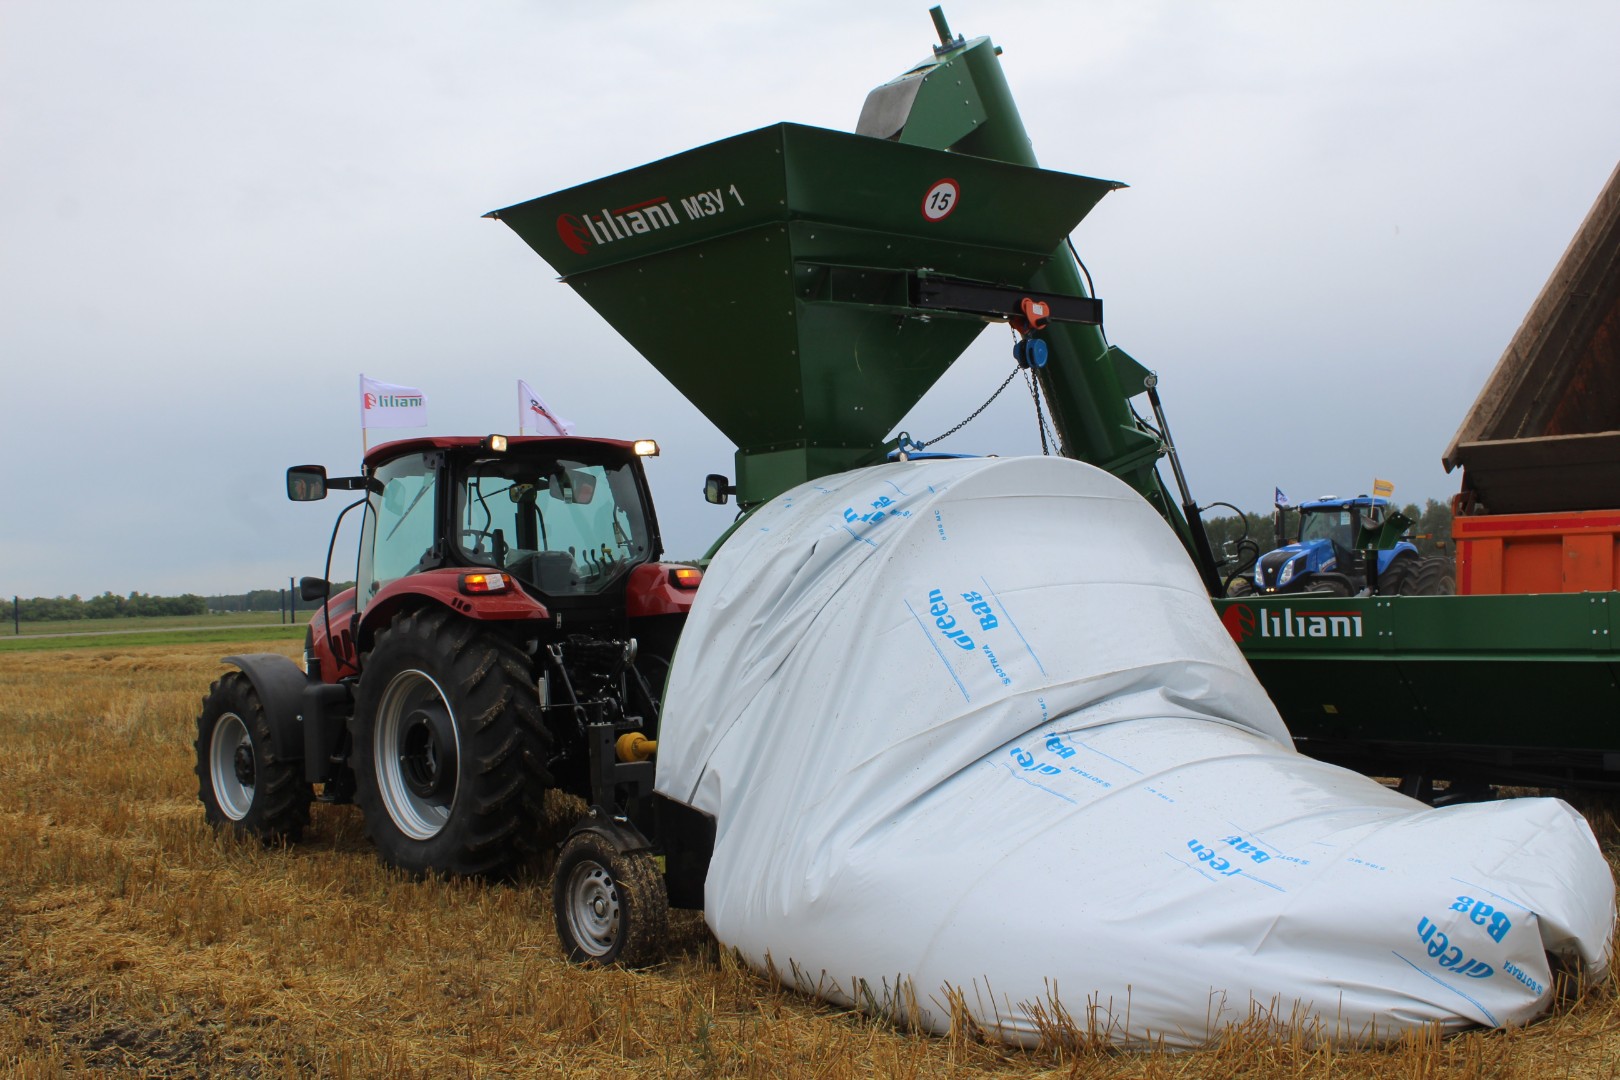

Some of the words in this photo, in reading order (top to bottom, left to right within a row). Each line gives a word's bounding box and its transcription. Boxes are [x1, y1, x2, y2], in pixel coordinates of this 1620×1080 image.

[582, 198, 680, 244] liliani
[729, 184, 744, 206] 1
[931, 191, 952, 211] 15
[379, 394, 423, 408] liliani
[929, 588, 976, 651] Green
[960, 590, 999, 631] Bag
[1260, 608, 1363, 638] liliani
[1187, 838, 1242, 877] reen
[1449, 895, 1512, 944] Bag
[1416, 916, 1495, 979] Green
